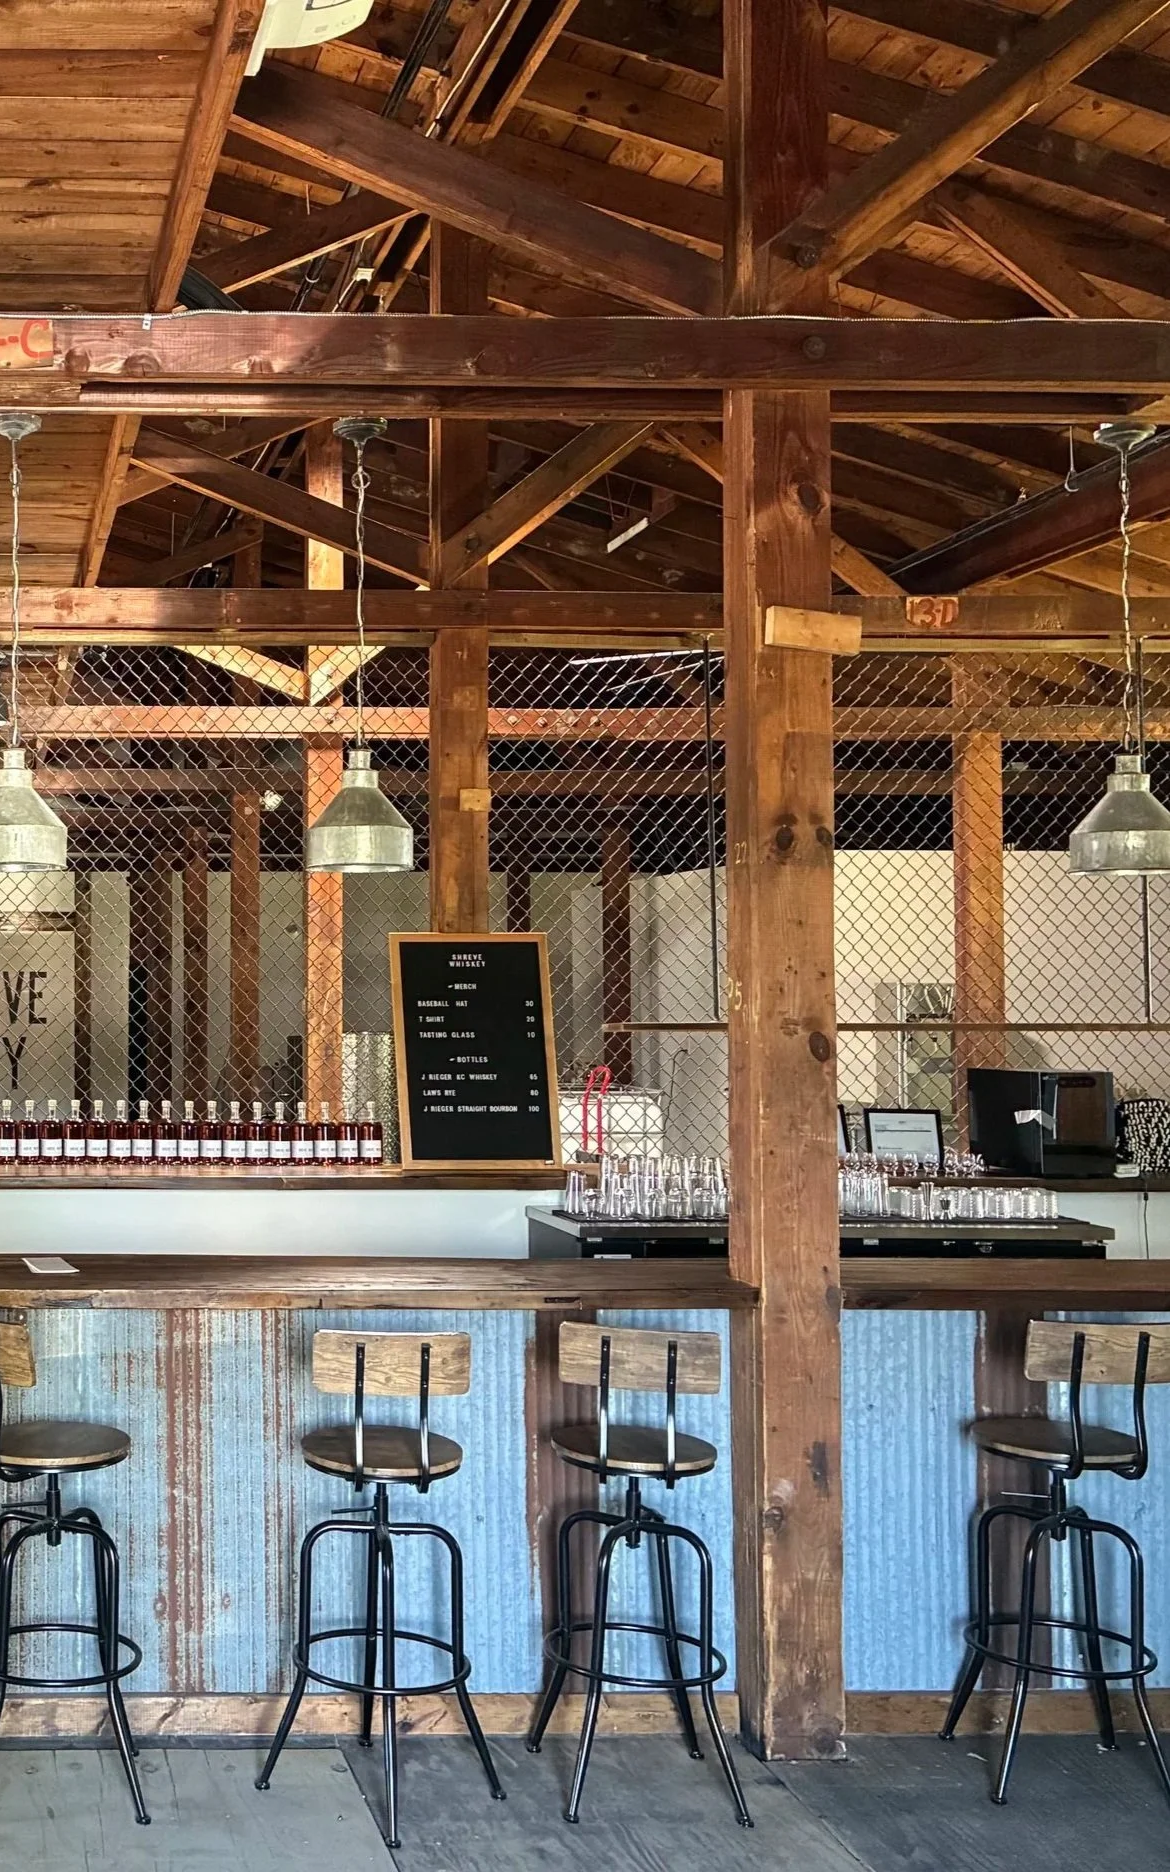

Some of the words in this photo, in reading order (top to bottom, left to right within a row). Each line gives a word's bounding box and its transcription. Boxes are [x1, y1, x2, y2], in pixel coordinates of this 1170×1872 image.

[451, 953, 483, 961] SHREVE
[448, 960, 486, 968] WHISKEY
[417, 1000, 450, 1008] BASEBALL
[455, 1000, 469, 1008] HAT
[425, 1015, 445, 1023] SHIRT
[525, 1015, 536, 1023] 20
[419, 1031, 448, 1039] TASTING
[451, 1031, 476, 1039] GLASS
[527, 1031, 536, 1039] 10
[428, 1073, 453, 1081] RIEGER
[468, 1073, 498, 1081] WHISKEY
[422, 1089, 442, 1097] LAWS
[444, 1089, 457, 1097] RYE
[430, 1105, 454, 1113] RIEGER
[457, 1105, 488, 1113] STRAIGHT
[489, 1105, 518, 1113] BOURBON
[528, 1105, 540, 1113] 100
